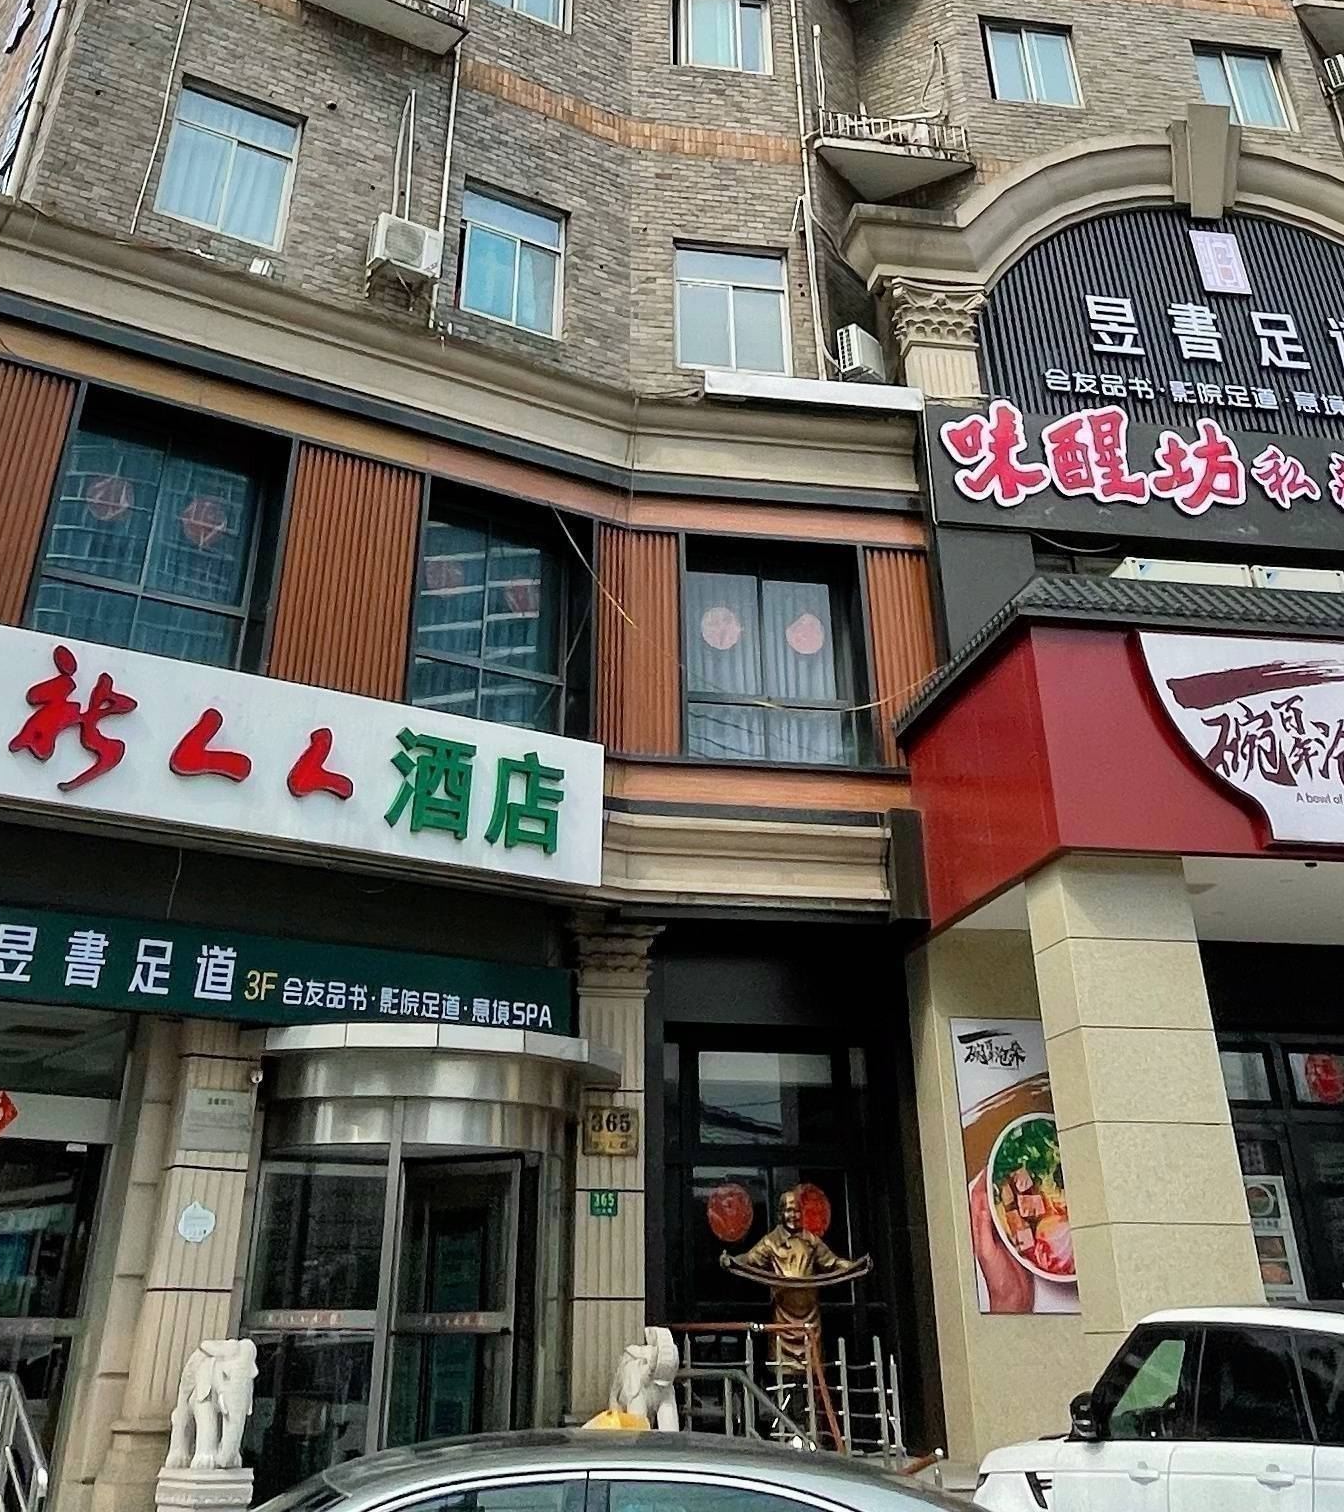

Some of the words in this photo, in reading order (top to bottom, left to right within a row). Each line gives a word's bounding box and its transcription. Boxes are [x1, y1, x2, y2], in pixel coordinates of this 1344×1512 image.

[940, 399, 1248, 517] 味醒坊
[1296, 792, 1305, 803] A
[1306, 792, 1331, 804] bowl
[1333, 793, 1343, 805] of
[243, 969, 278, 1002] 3F
[591, 1112, 631, 1133] 365
[592, 1191, 615, 1208] 365
